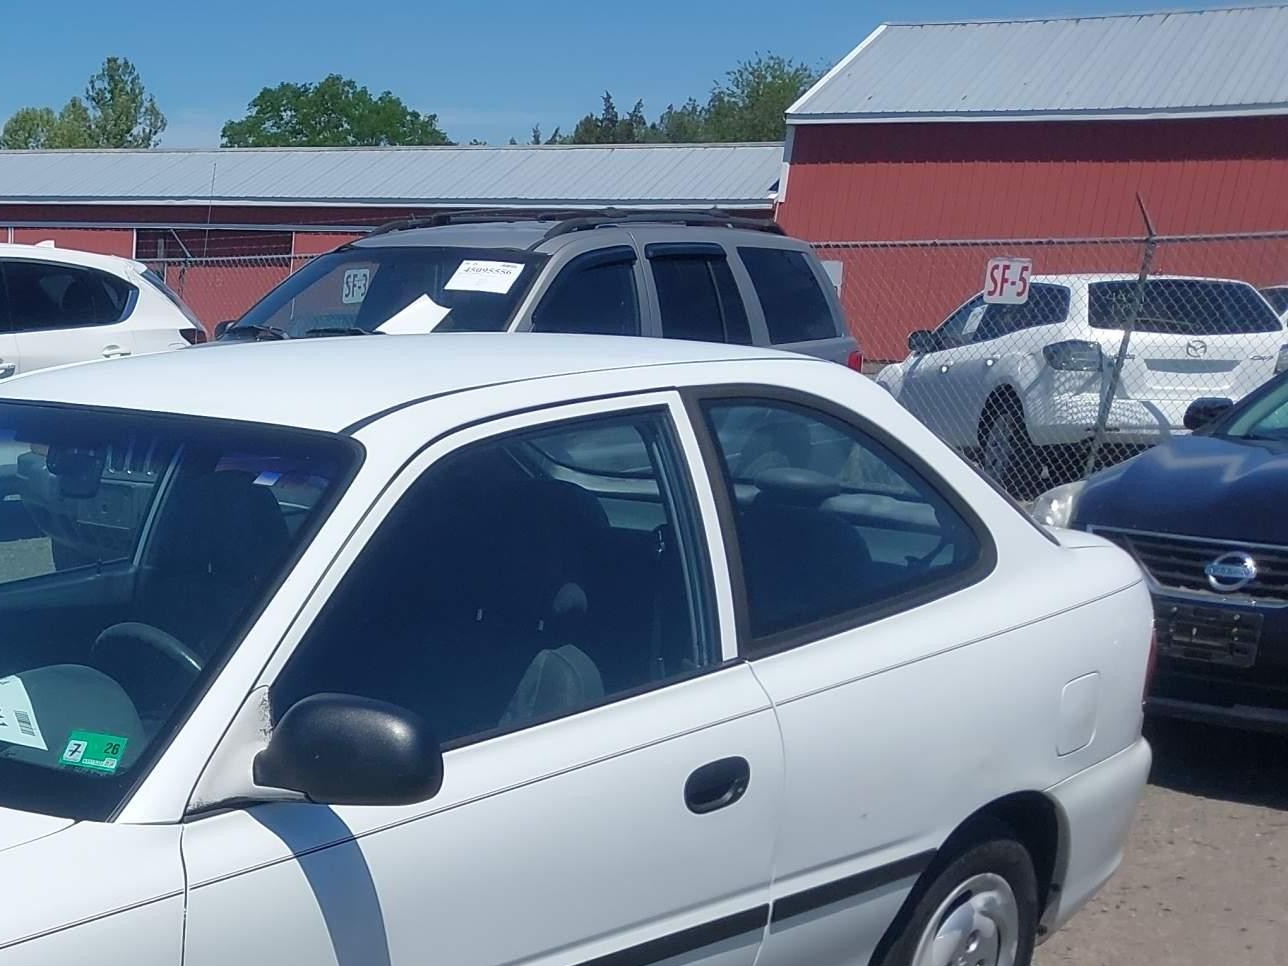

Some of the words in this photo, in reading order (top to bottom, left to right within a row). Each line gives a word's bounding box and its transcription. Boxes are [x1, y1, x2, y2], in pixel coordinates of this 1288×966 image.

[344, 273, 368, 298] SF-3
[987, 264, 1030, 297] SF-5
[68, 743, 82, 758] 7
[103, 742, 121, 756] 26
